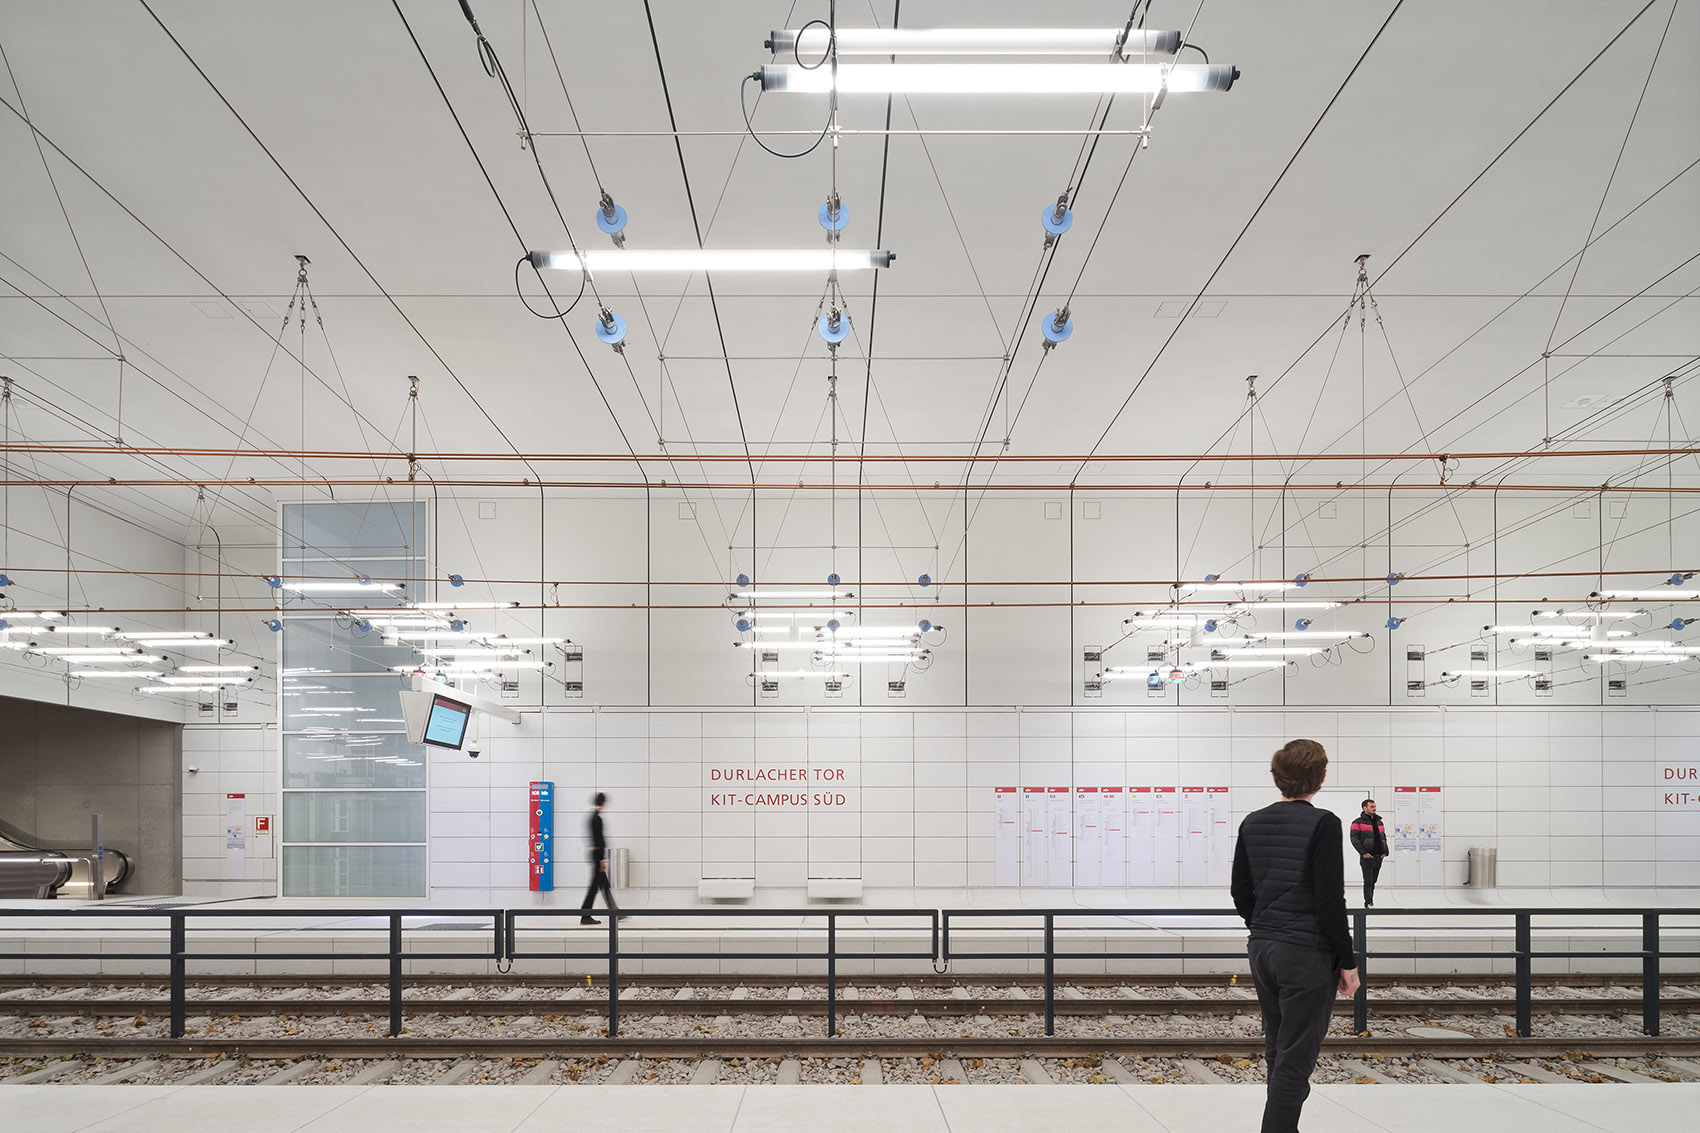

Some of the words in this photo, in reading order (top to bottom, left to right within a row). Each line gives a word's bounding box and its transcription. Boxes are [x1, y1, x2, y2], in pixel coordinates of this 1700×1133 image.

[711, 769, 807, 781] DURLACHER
[813, 769, 845, 781] TOR
[711, 793, 808, 806] KIT-CAMPUS
[813, 791, 846, 806] SÜD
[1664, 793, 1700, 805] KIT-
[257, 818, 266, 830] F
